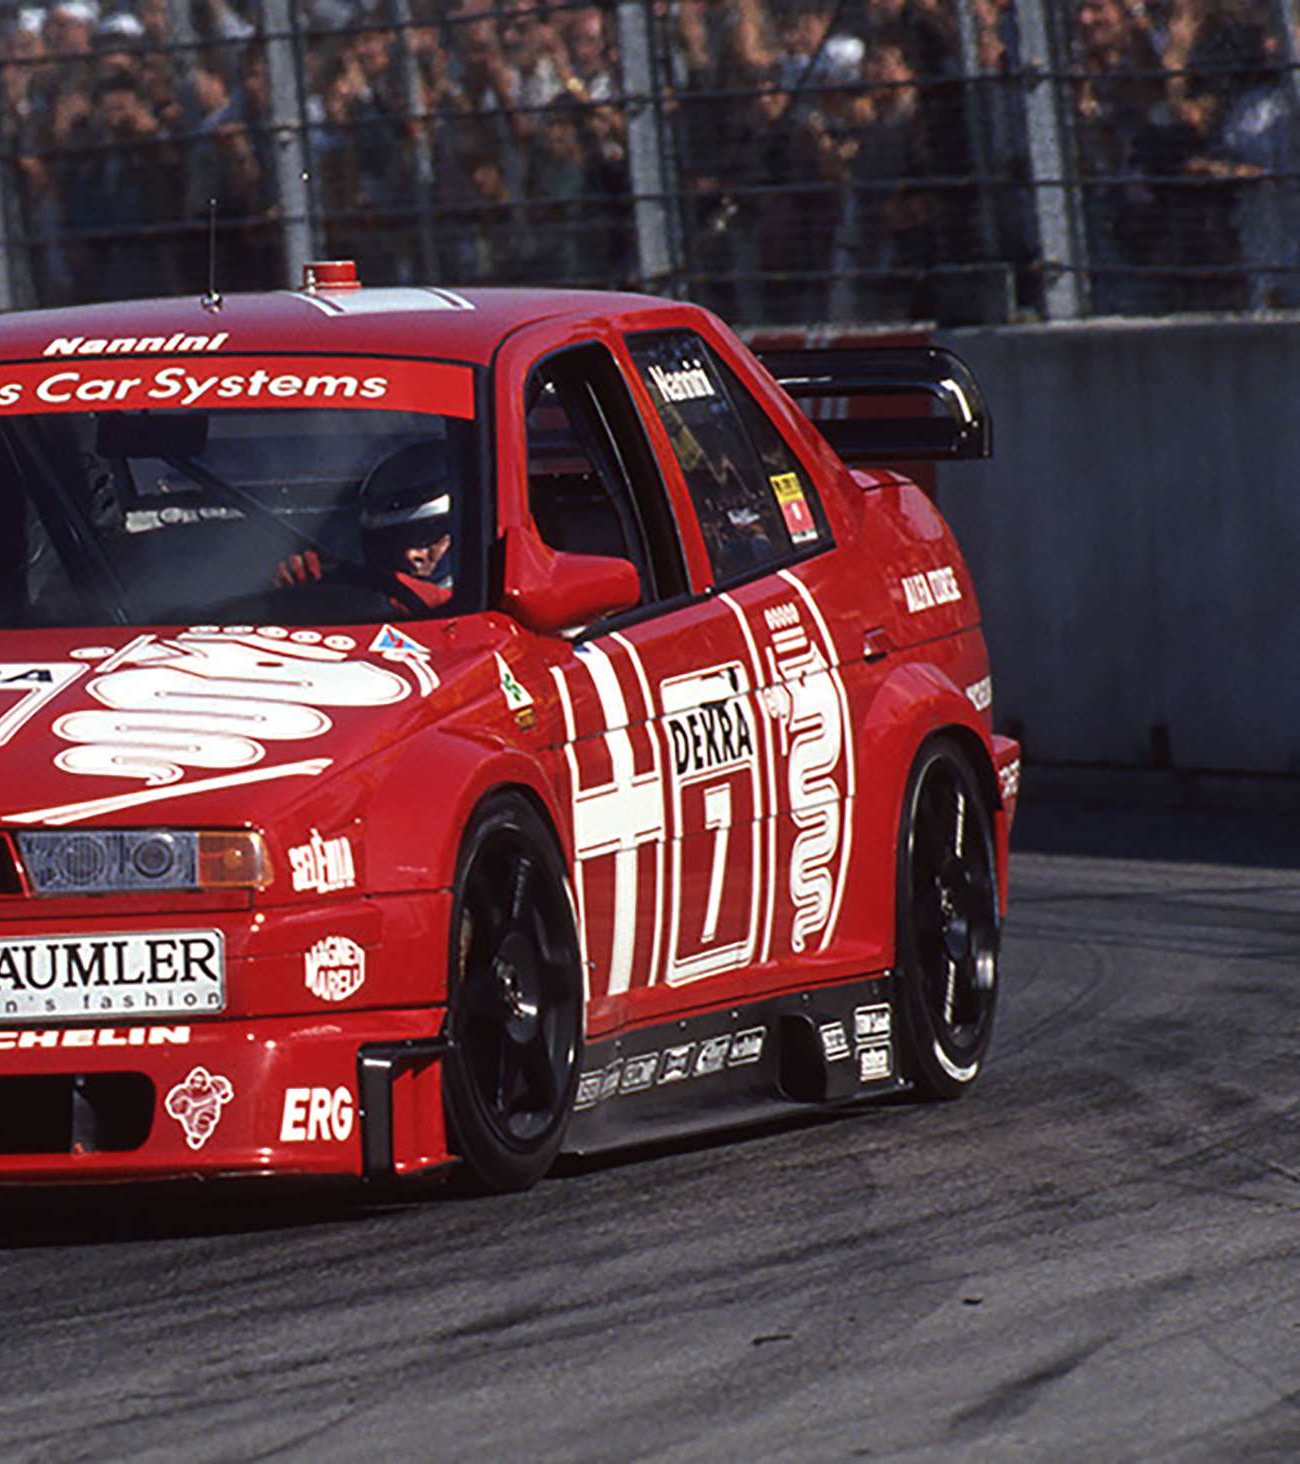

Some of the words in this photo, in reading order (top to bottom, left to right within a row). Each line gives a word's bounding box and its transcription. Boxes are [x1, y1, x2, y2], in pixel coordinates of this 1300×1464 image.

[43, 332, 229, 356] Nannini
[36, 372, 141, 404] Car
[148, 367, 388, 405] Systems
[647, 358, 715, 402] Nannini
[668, 701, 753, 776] DEKRA
[701, 782, 731, 944] 7
[83, 990, 221, 1011] fashion
[279, 1086, 354, 1142] ERG
